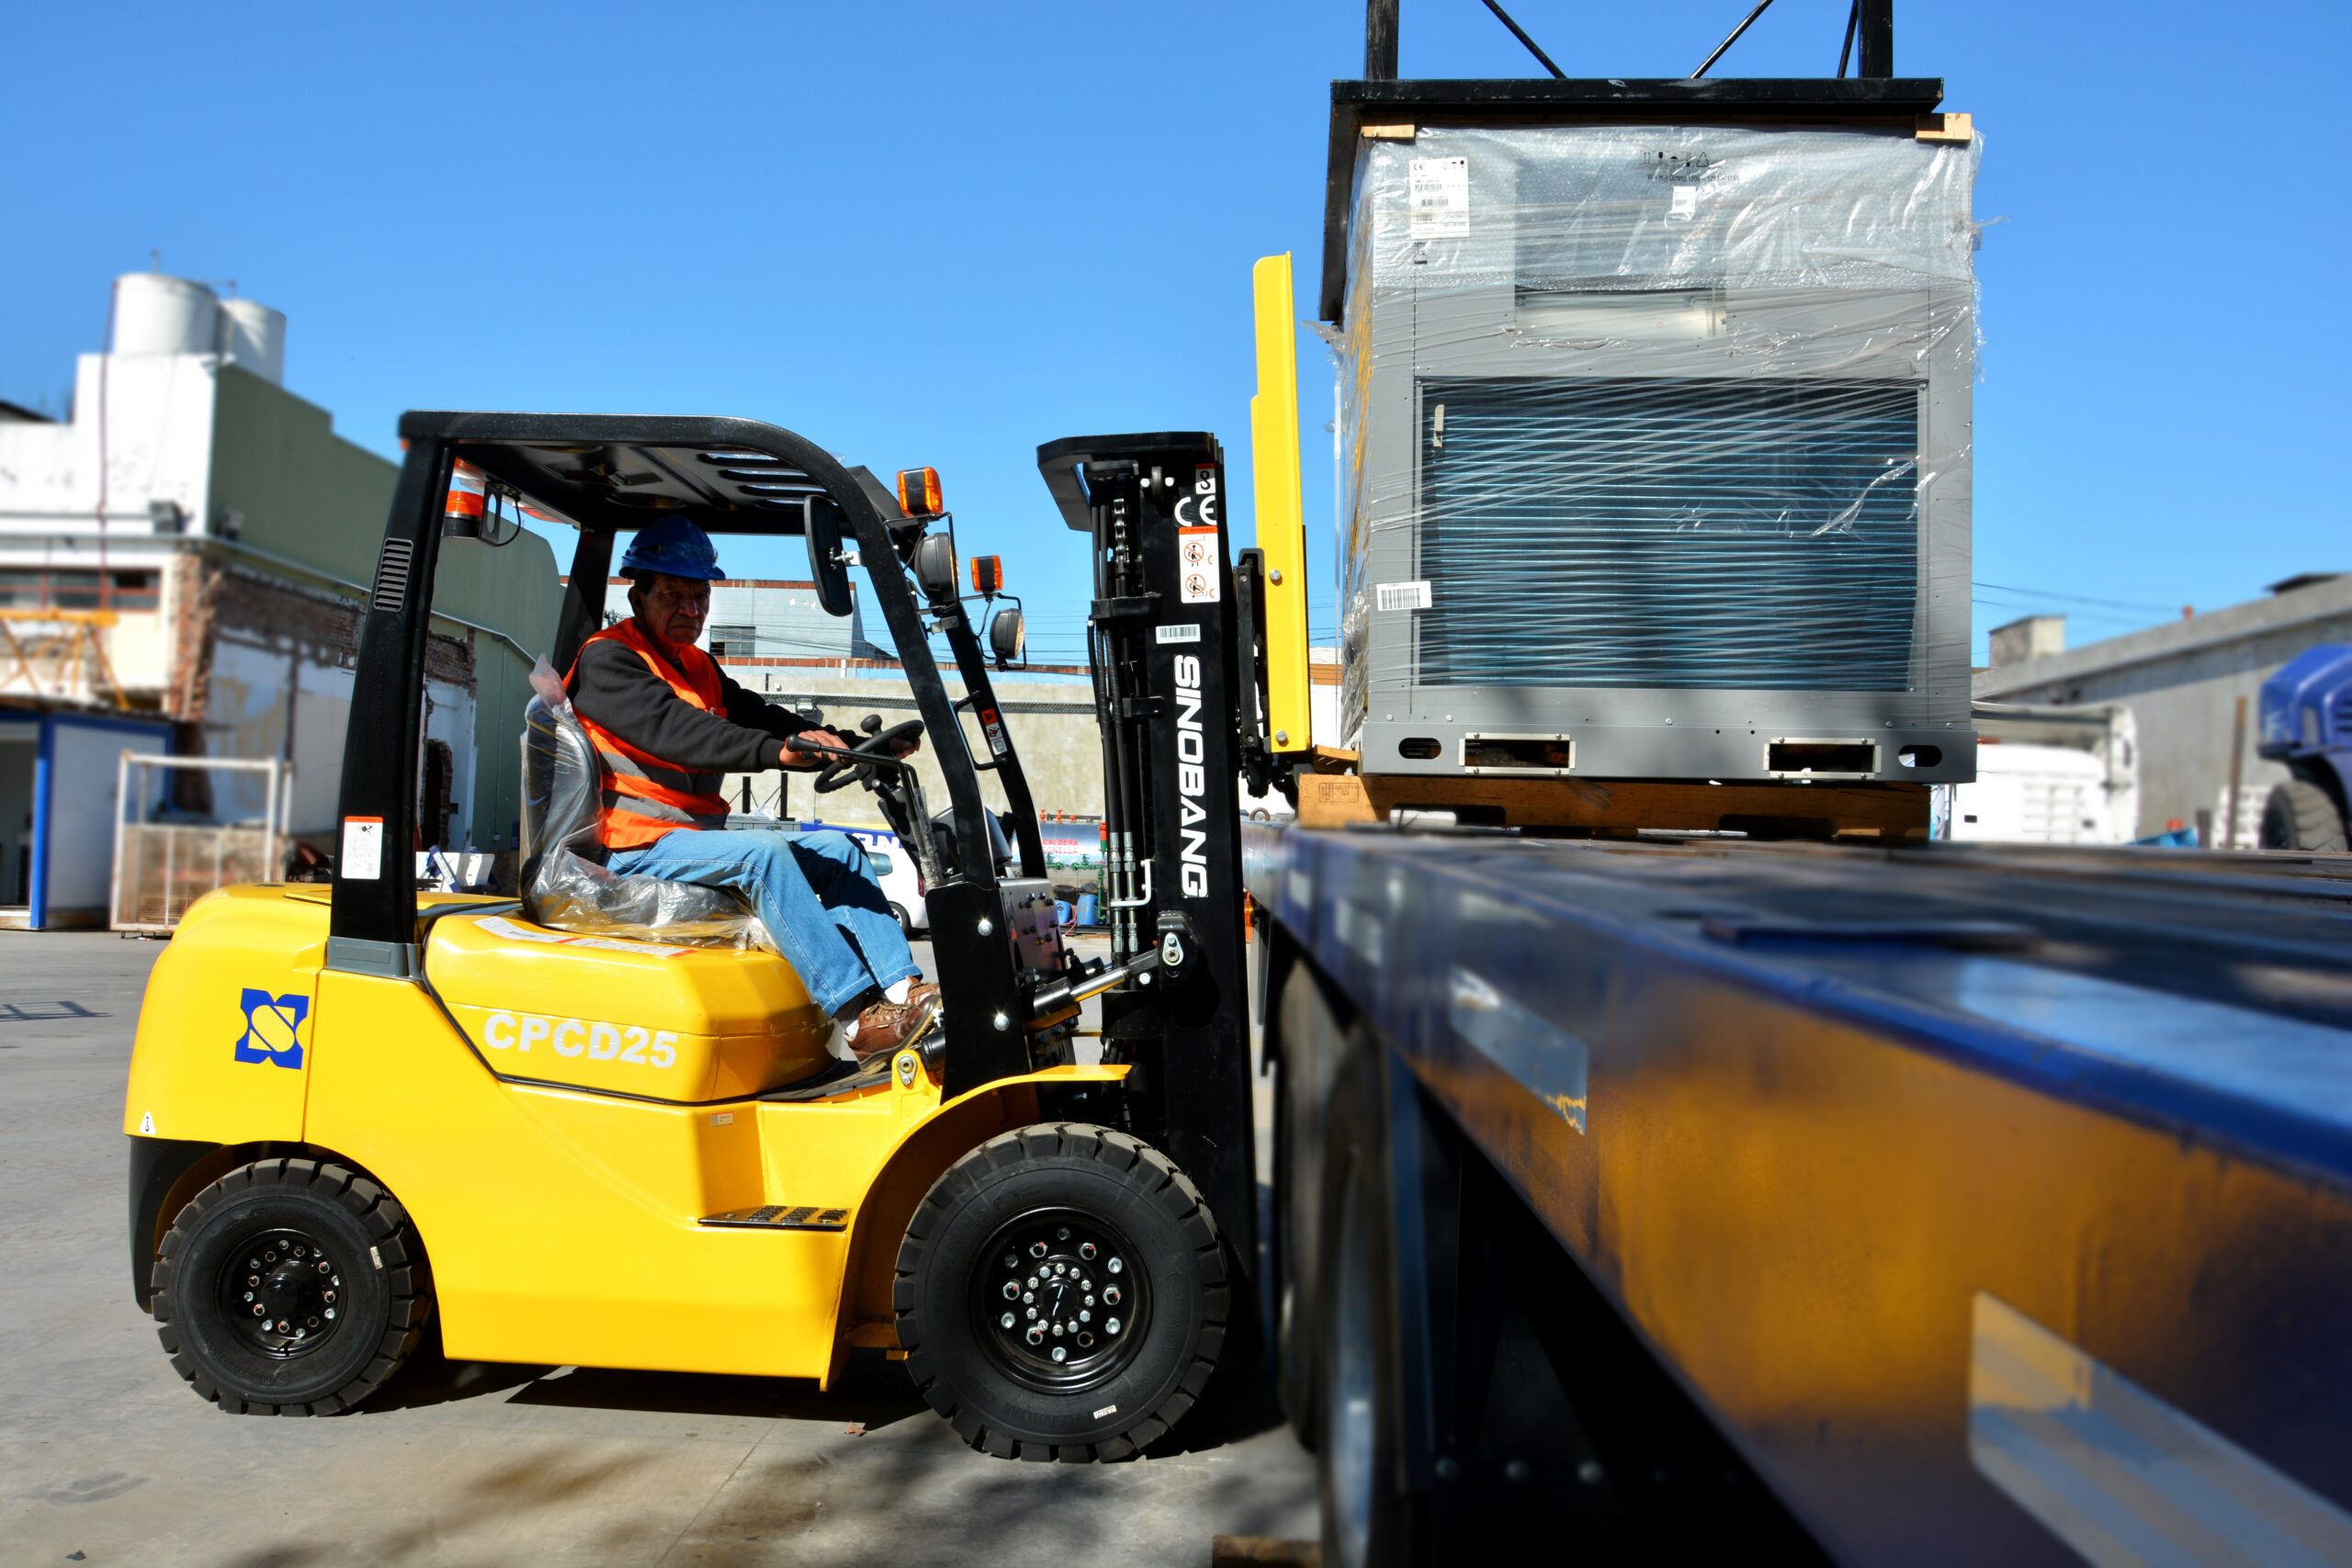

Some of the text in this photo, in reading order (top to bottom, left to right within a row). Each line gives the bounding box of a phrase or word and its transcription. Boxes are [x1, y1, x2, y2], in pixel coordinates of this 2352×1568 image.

[1174, 495, 1218, 527] CE
[1174, 654, 1208, 897] SINOBANG
[1042, 838, 1079, 846] CALDERA
[482, 1013, 678, 1068] CPCD25
